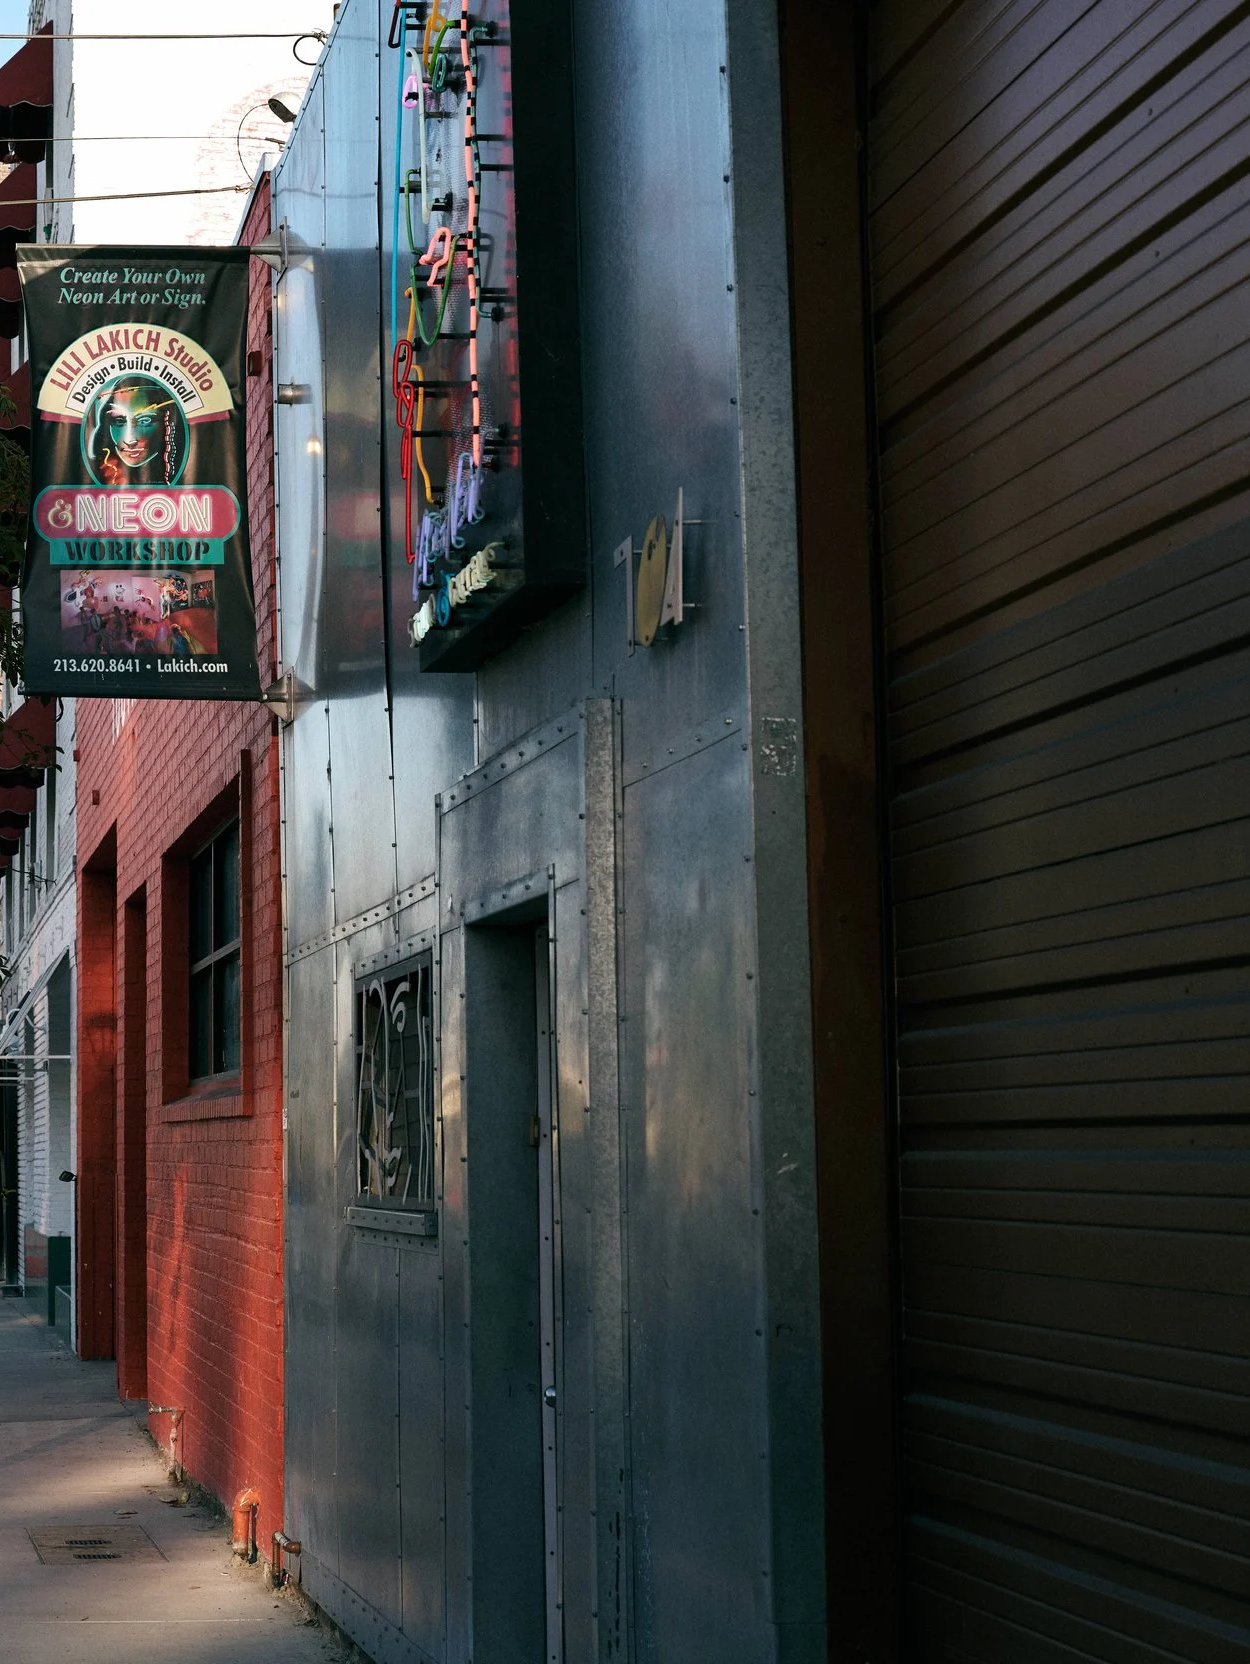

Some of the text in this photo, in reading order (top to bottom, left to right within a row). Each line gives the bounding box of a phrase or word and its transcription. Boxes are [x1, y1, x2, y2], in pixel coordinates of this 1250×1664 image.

[60, 267, 206, 284] Create Your Own
[57, 287, 206, 309] Neon Art or Sign.
[49, 328, 214, 392] LILI LAKICH Studio
[71, 355, 197, 404] Design Build Install
[75, 493, 212, 534] NEON
[64, 541, 211, 561] WORKSHOP
[53, 658, 229, 673] 213.620.8641 Lakich.com
